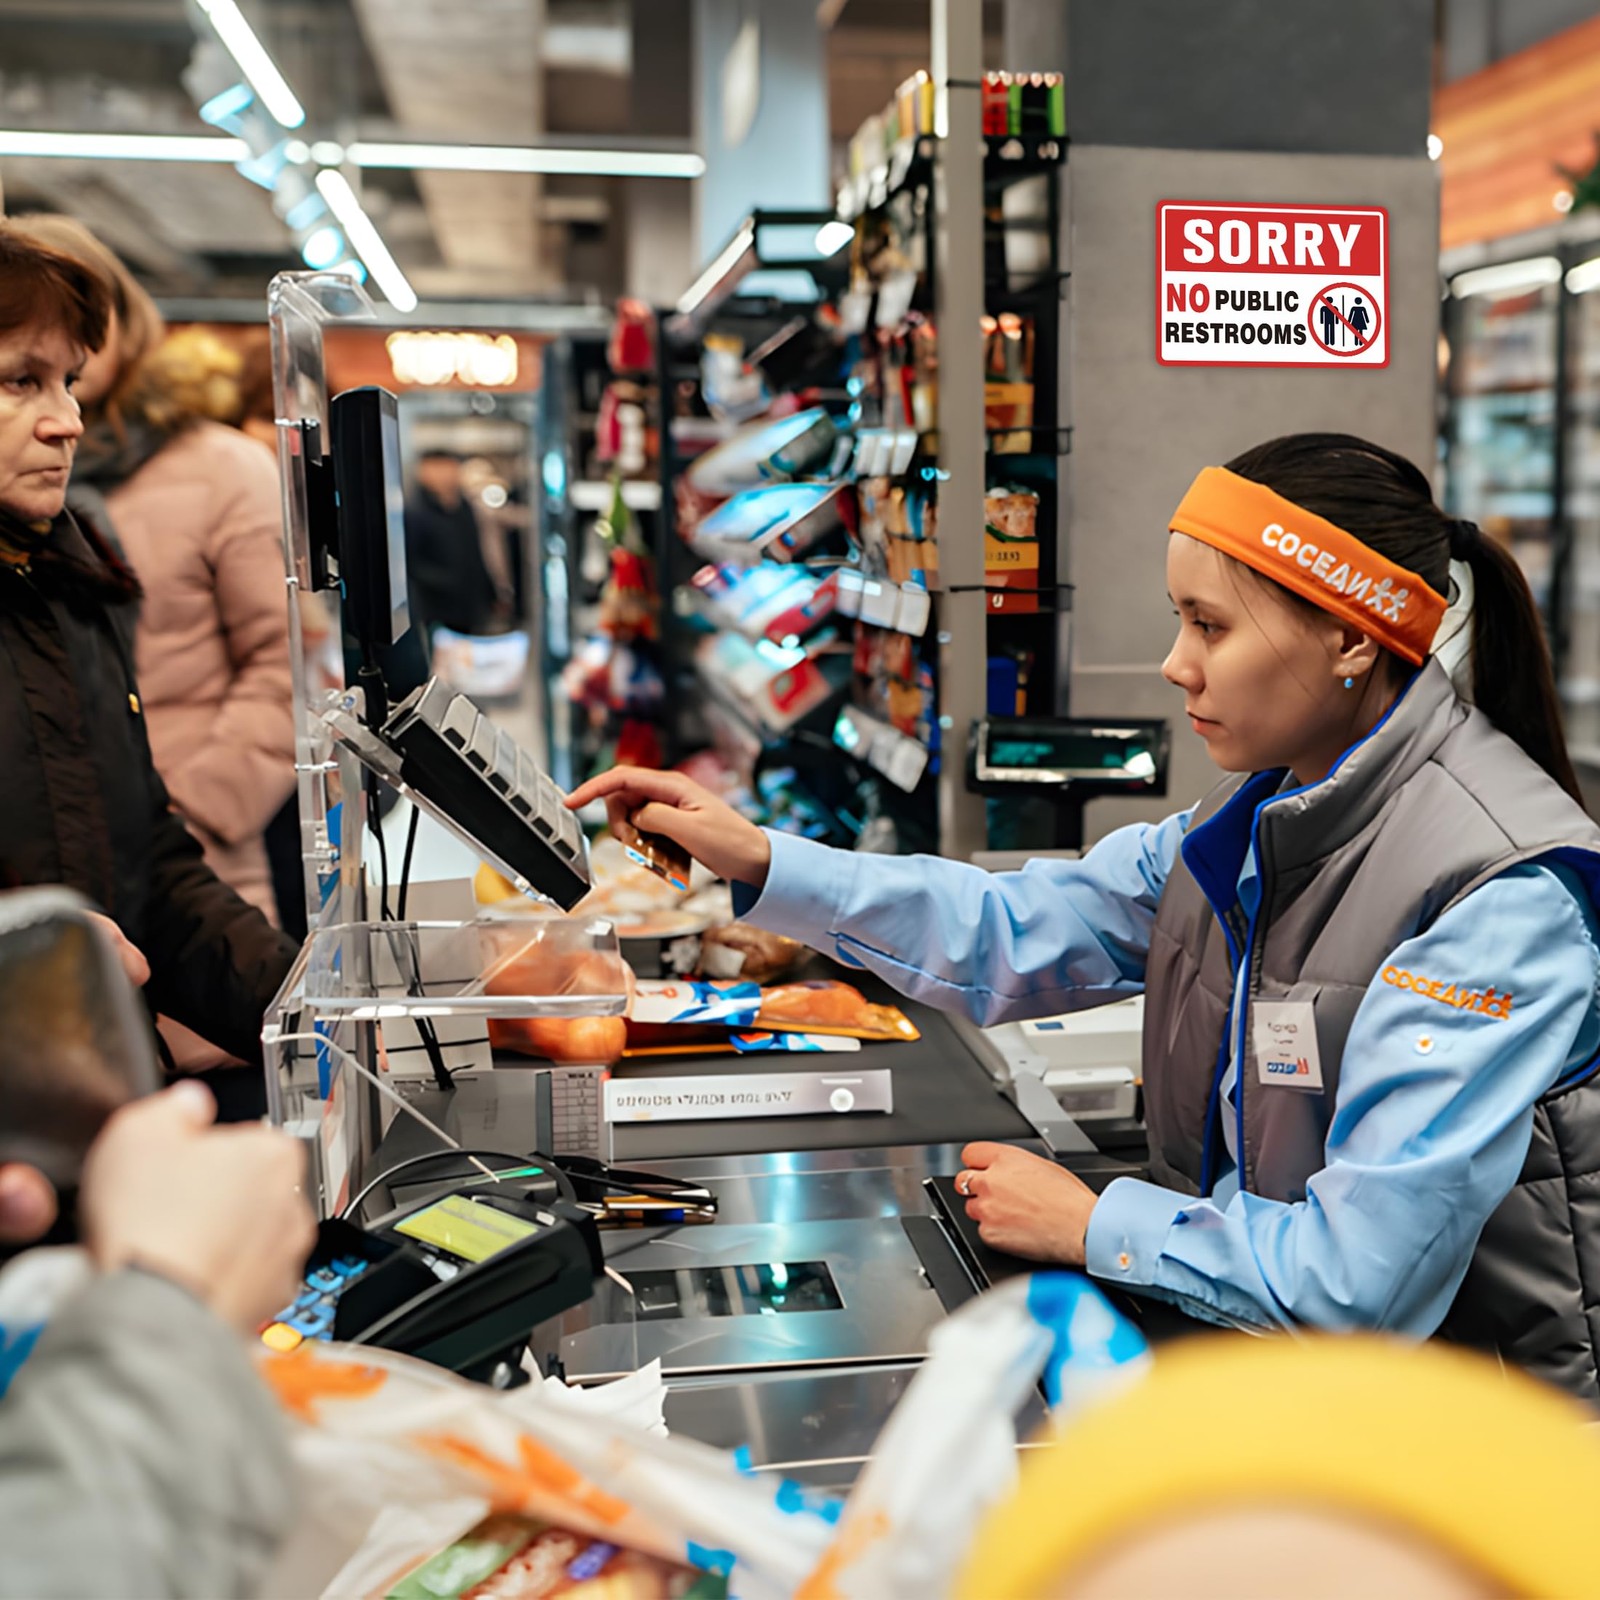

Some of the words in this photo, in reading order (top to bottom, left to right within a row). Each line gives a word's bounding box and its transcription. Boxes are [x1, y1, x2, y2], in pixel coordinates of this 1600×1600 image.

[1183, 218, 1362, 267] SORRY
[1166, 283, 1210, 313] NO
[1215, 289, 1299, 312] PUBLIC
[1165, 322, 1307, 345] RESTROOMS
